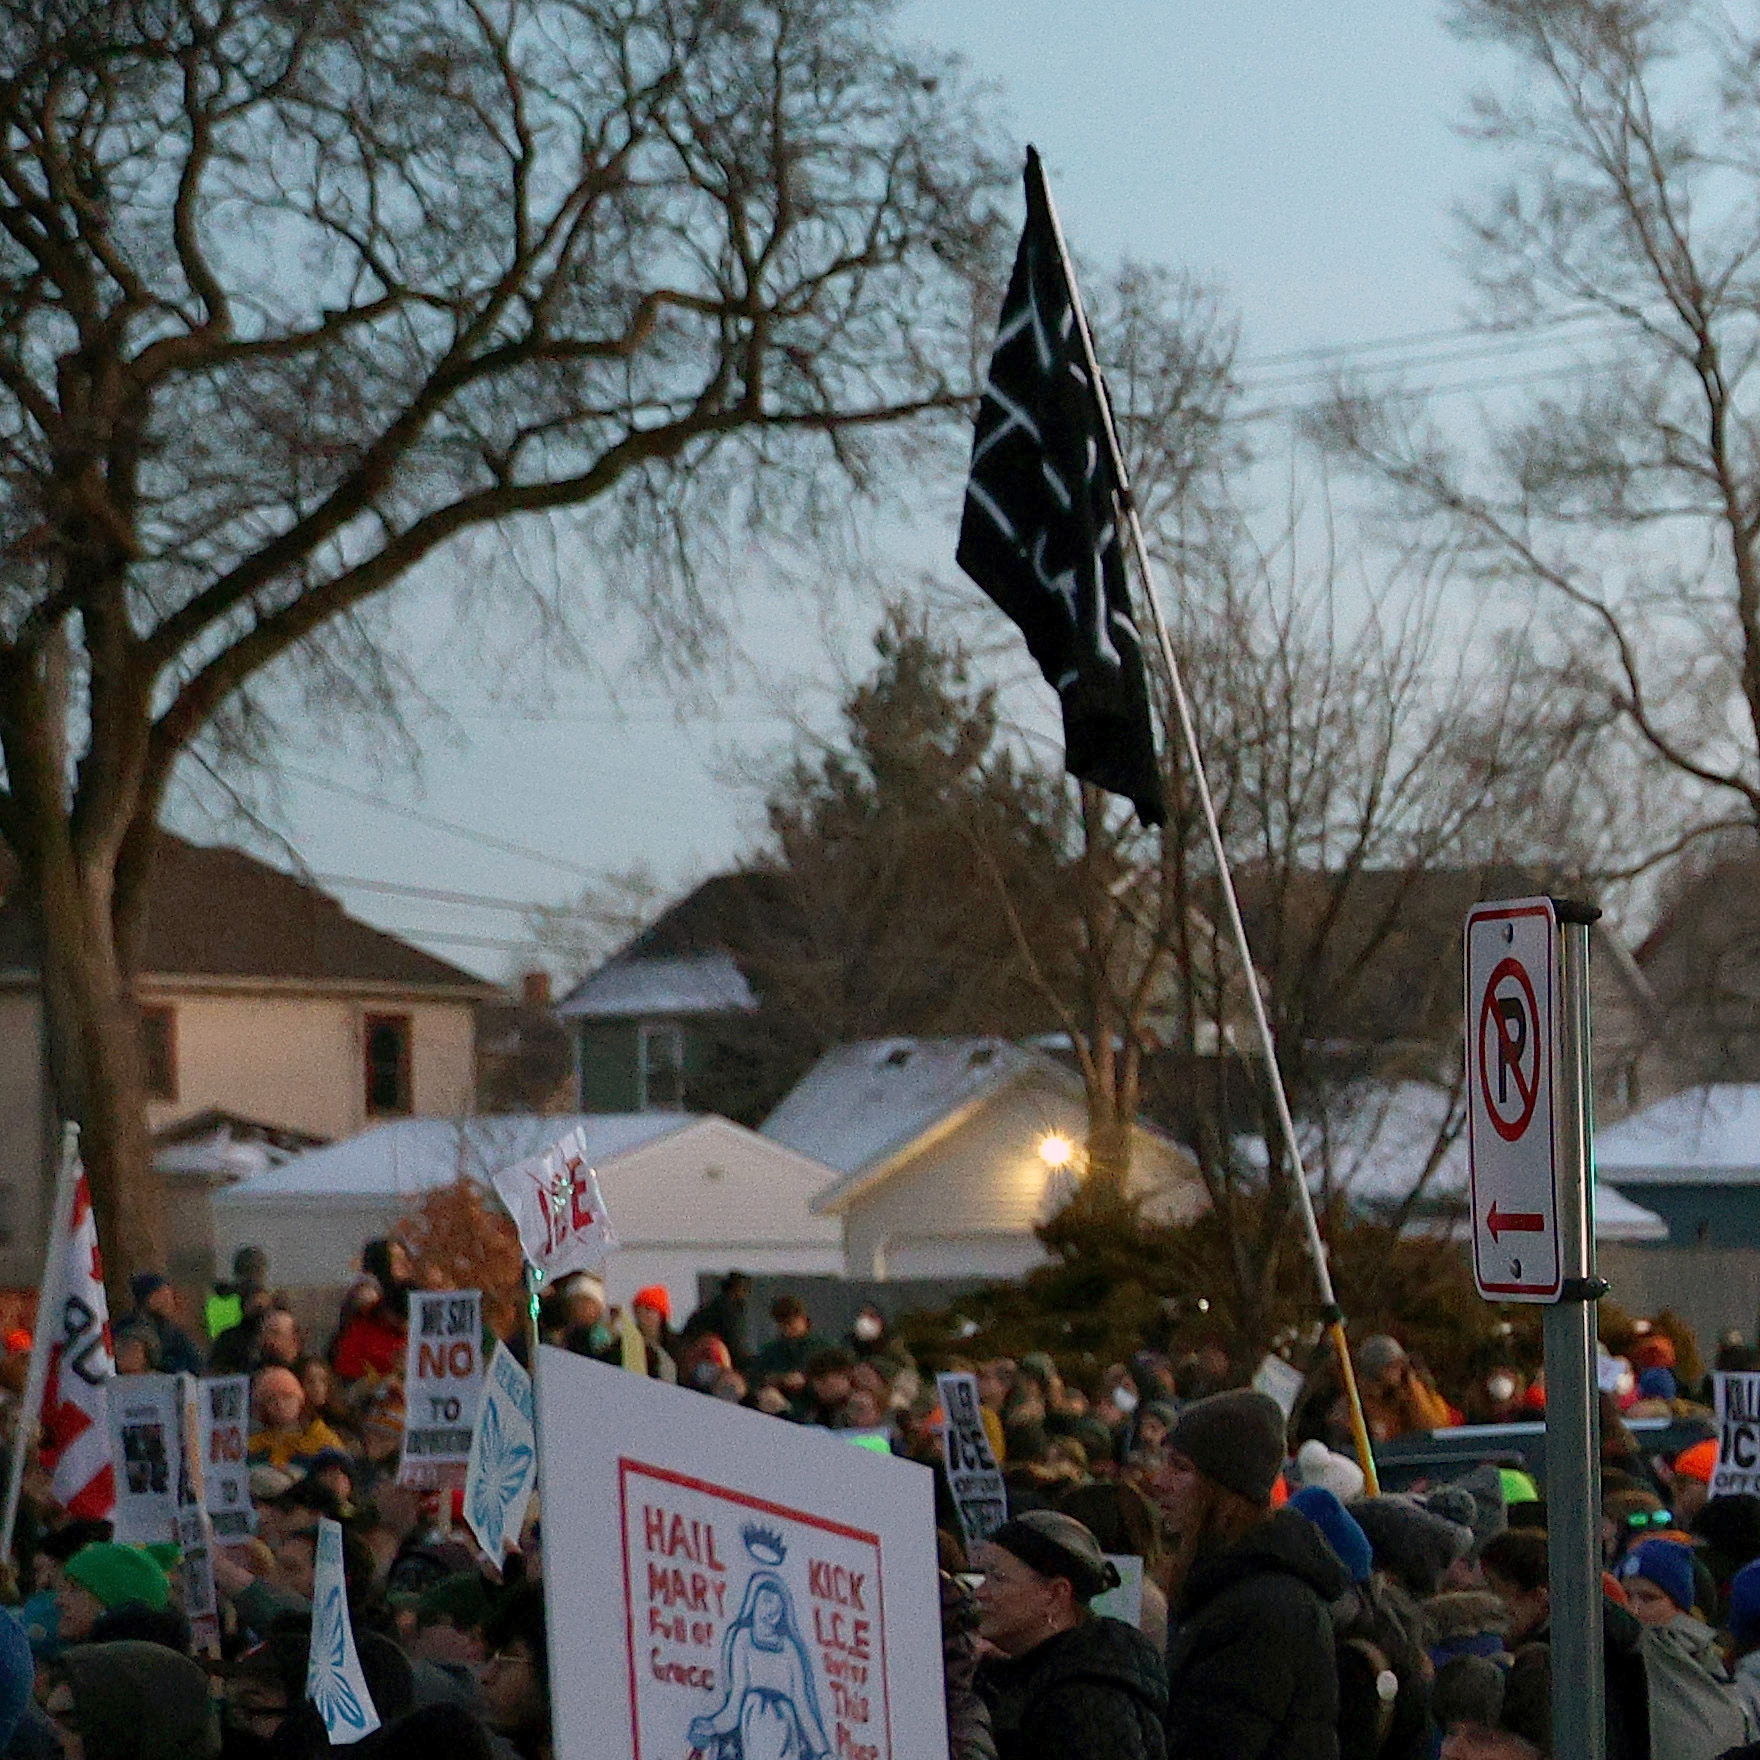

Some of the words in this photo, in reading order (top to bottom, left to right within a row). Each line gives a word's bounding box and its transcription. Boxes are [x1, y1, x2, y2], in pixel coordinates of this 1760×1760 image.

[418, 1341, 473, 1379] NO
[429, 1396, 460, 1421] TO
[645, 1505, 727, 1572] HAIL
[647, 1562, 727, 1617] MARY
[809, 1557, 866, 1611] KICK
